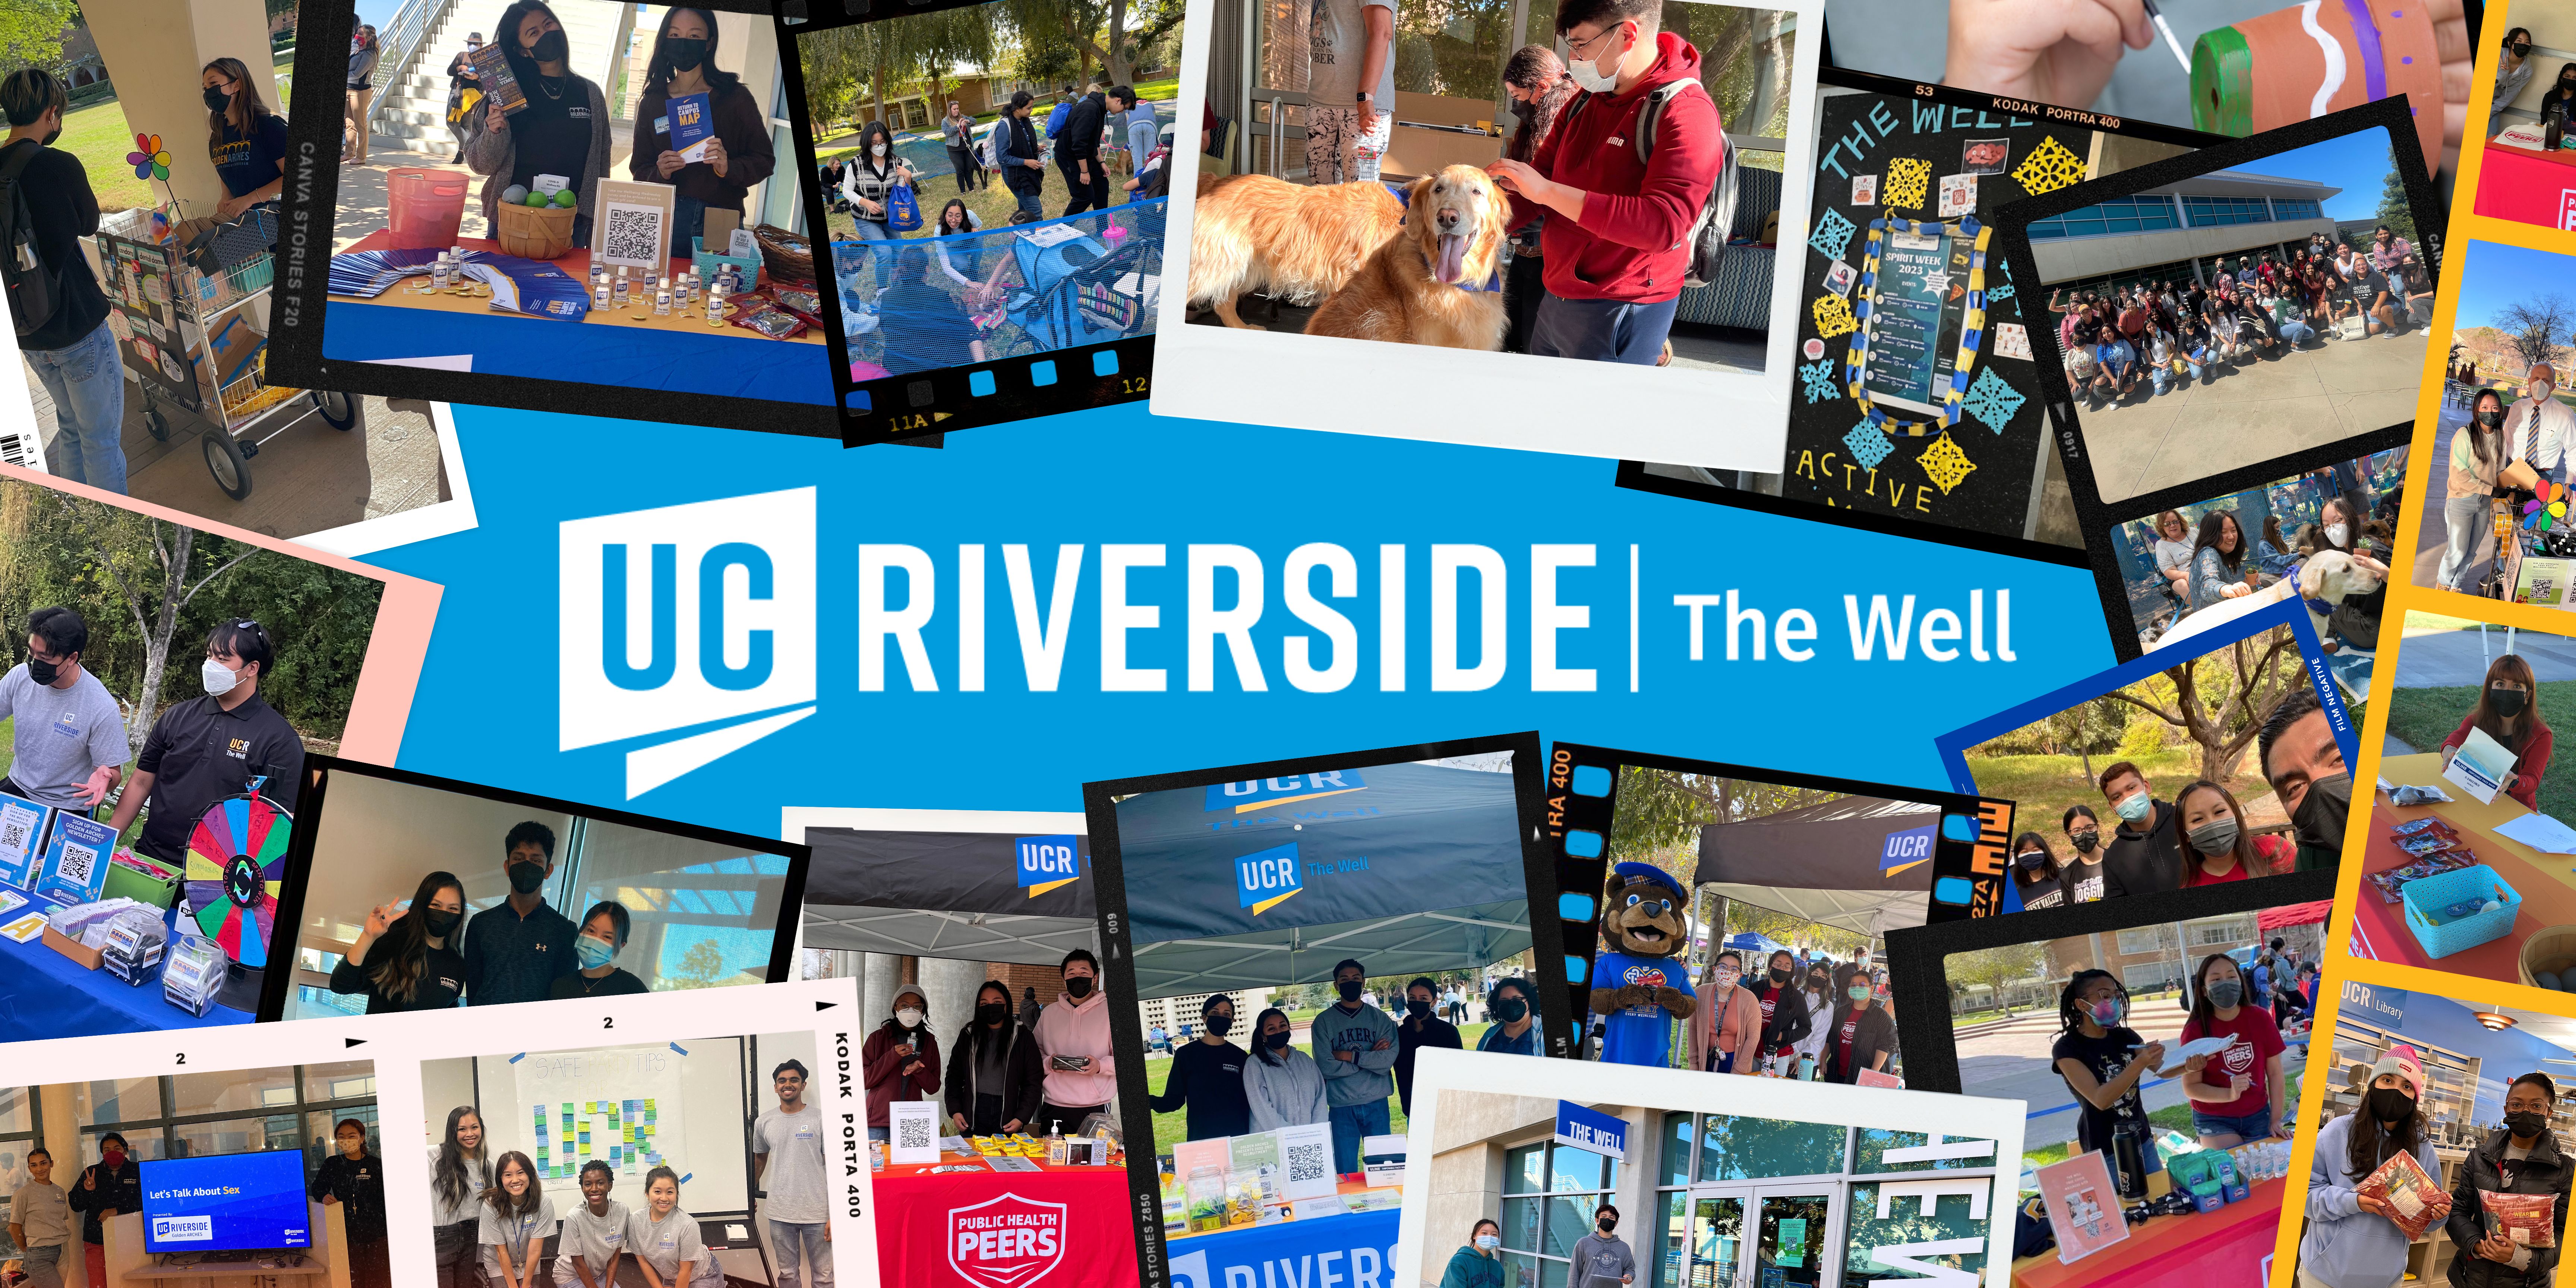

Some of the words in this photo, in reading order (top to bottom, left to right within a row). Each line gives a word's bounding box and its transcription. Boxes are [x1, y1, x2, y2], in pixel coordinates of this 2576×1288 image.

[500, 77, 514, 85] TIME
[678, 107, 700, 116] CAMPUS
[679, 113, 700, 126] MAP
[1820, 100, 1899, 180] THE
[2508, 133, 2538, 142] PEERS
[139, 253, 151, 262] dental
[151, 256, 164, 265] dams
[1886, 253, 1914, 263] SPIRIT
[1916, 255, 1941, 265] WEEK
[1898, 265, 1923, 275] 2023
[546, 300, 560, 314] MAP
[131, 319, 148, 332] Flavored
[1796, 449, 1932, 513] ACTIVE
[54, 722, 79, 736] RIVERSIDE
[230, 738, 250, 751] UCR
[2456, 761, 2467, 771] ULINE
[2468, 770, 2482, 780] DISPOSABLE
[7, 817, 29, 826] NEWSLETTER!
[1205, 817, 1279, 831] The
[1293, 806, 1386, 819] Well
[66, 823, 85, 832] GOLDEN
[85, 829, 106, 839] ARCHES'
[67, 829, 98, 843] NEWSLETTER
[1887, 836, 1928, 857] UCR
[1023, 844, 1073, 873] UCR
[225, 860, 234, 874] WIN
[252, 862, 262, 882] SPIN
[1242, 858, 1295, 891] UCR
[1307, 862, 1334, 877] The
[1337, 856, 1370, 873] Well
[224, 874, 229, 884] TO
[259, 881, 263, 889] TO
[6, 891, 25, 902] Drinking
[60, 892, 79, 903] RIVERSIDE
[225, 884, 235, 900] SPIN
[254, 889, 262, 904] WIN
[2041, 891, 2063, 910] VALLEY
[2341, 981, 2370, 1007] UCR
[2376, 1000, 2403, 1020] Library
[2226, 1049, 2252, 1065] PEERS
[536, 1058, 582, 1079] SAFE
[588, 1055, 630, 1076] PARTY
[635, 1053, 666, 1073] TIPS
[578, 1080, 613, 1099] FOR
[1569, 1121, 1591, 1143] THE
[1594, 1128, 1621, 1151] WELL
[150, 1190, 171, 1199] Let's
[172, 1188, 191, 1197] Talk
[193, 1187, 221, 1196] About
[223, 1186, 240, 1195] Sex
[159, 1224, 168, 1233] UC
[171, 1222, 208, 1232] RIVERSIDE
[959, 1215, 1004, 1230] PUBLIC
[1007, 1213, 1057, 1226] HEALTH
[605, 1234, 622, 1242] RIVERSIDE
[958, 1228, 1057, 1261] PEERS
